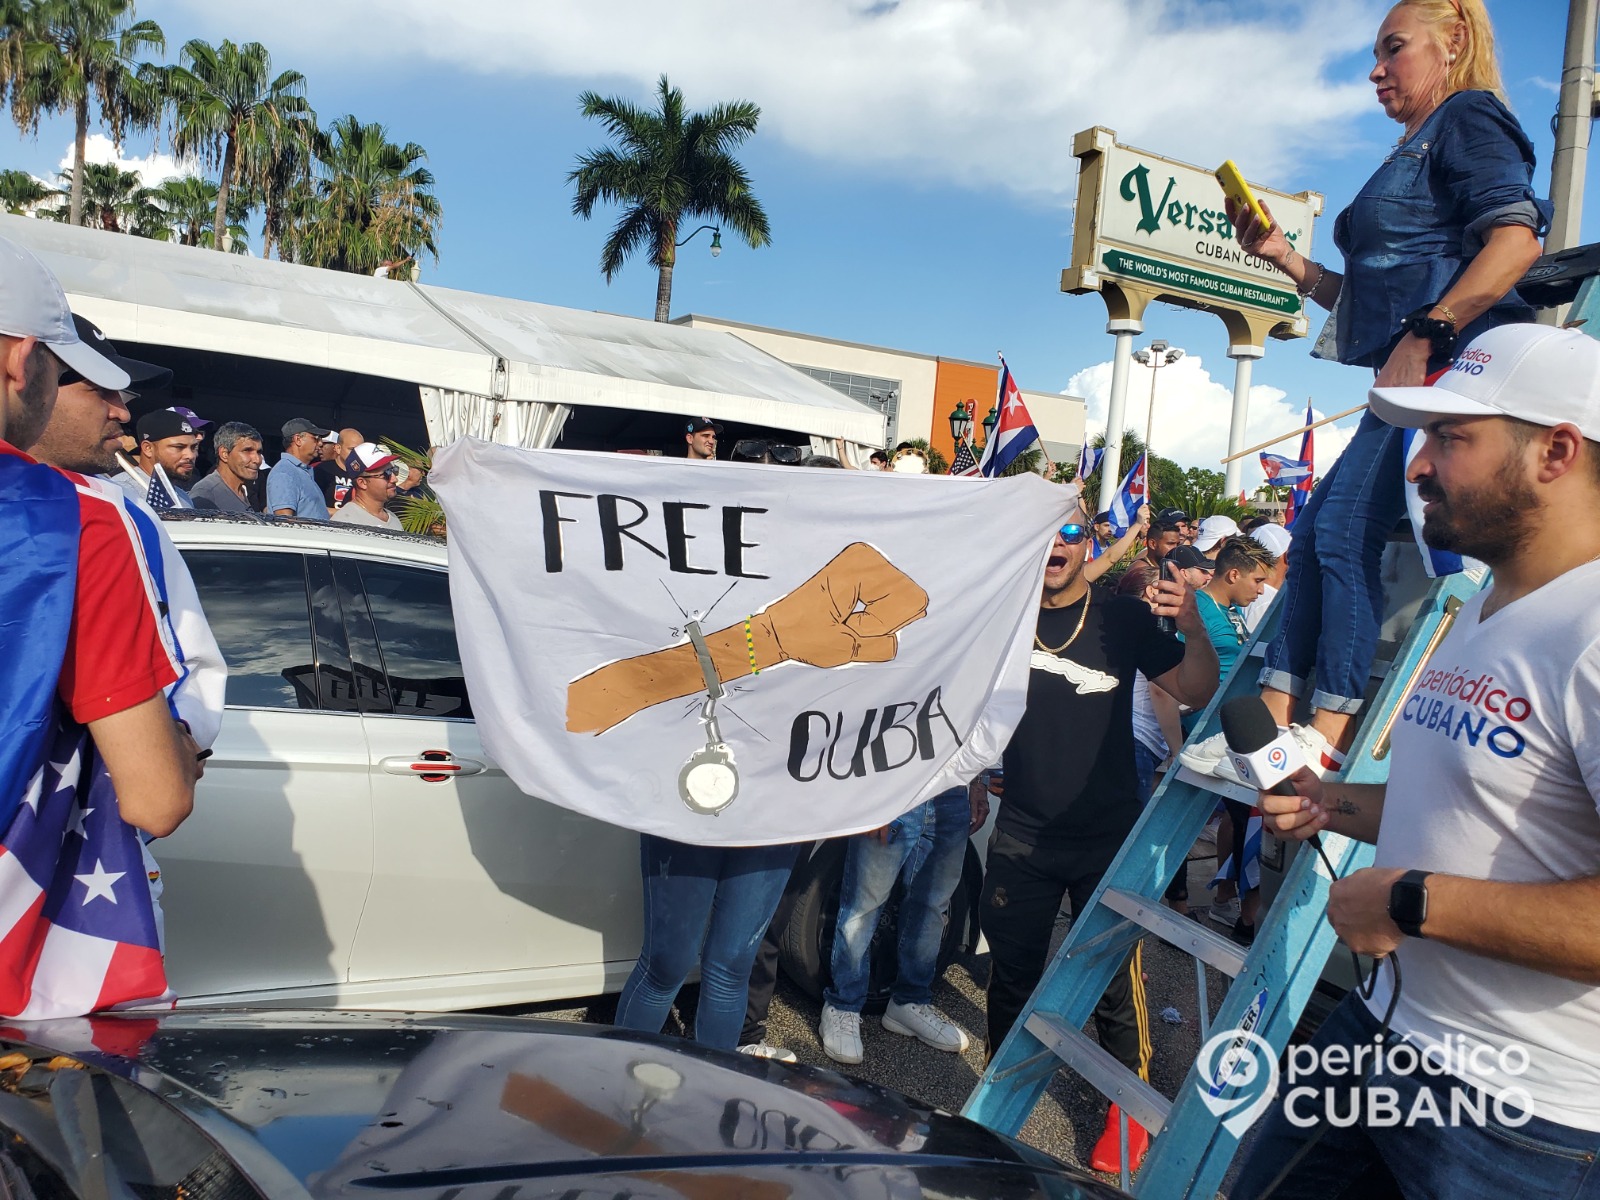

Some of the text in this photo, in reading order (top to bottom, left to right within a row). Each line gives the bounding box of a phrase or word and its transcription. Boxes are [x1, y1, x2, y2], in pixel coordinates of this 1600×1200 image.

[1119, 257, 1134, 271] THE
[1135, 262, 1168, 278] WORLD'S
[1168, 270, 1189, 284] MOST
[1190, 274, 1218, 291] FAMOUS
[1220, 281, 1243, 297] CUBAN
[1195, 241, 1241, 264] CUBAN
[539, 490, 771, 579] FREE
[1415, 666, 1531, 722] periódico
[787, 685, 963, 782] CUBA
[1403, 694, 1525, 758] CUBANO
